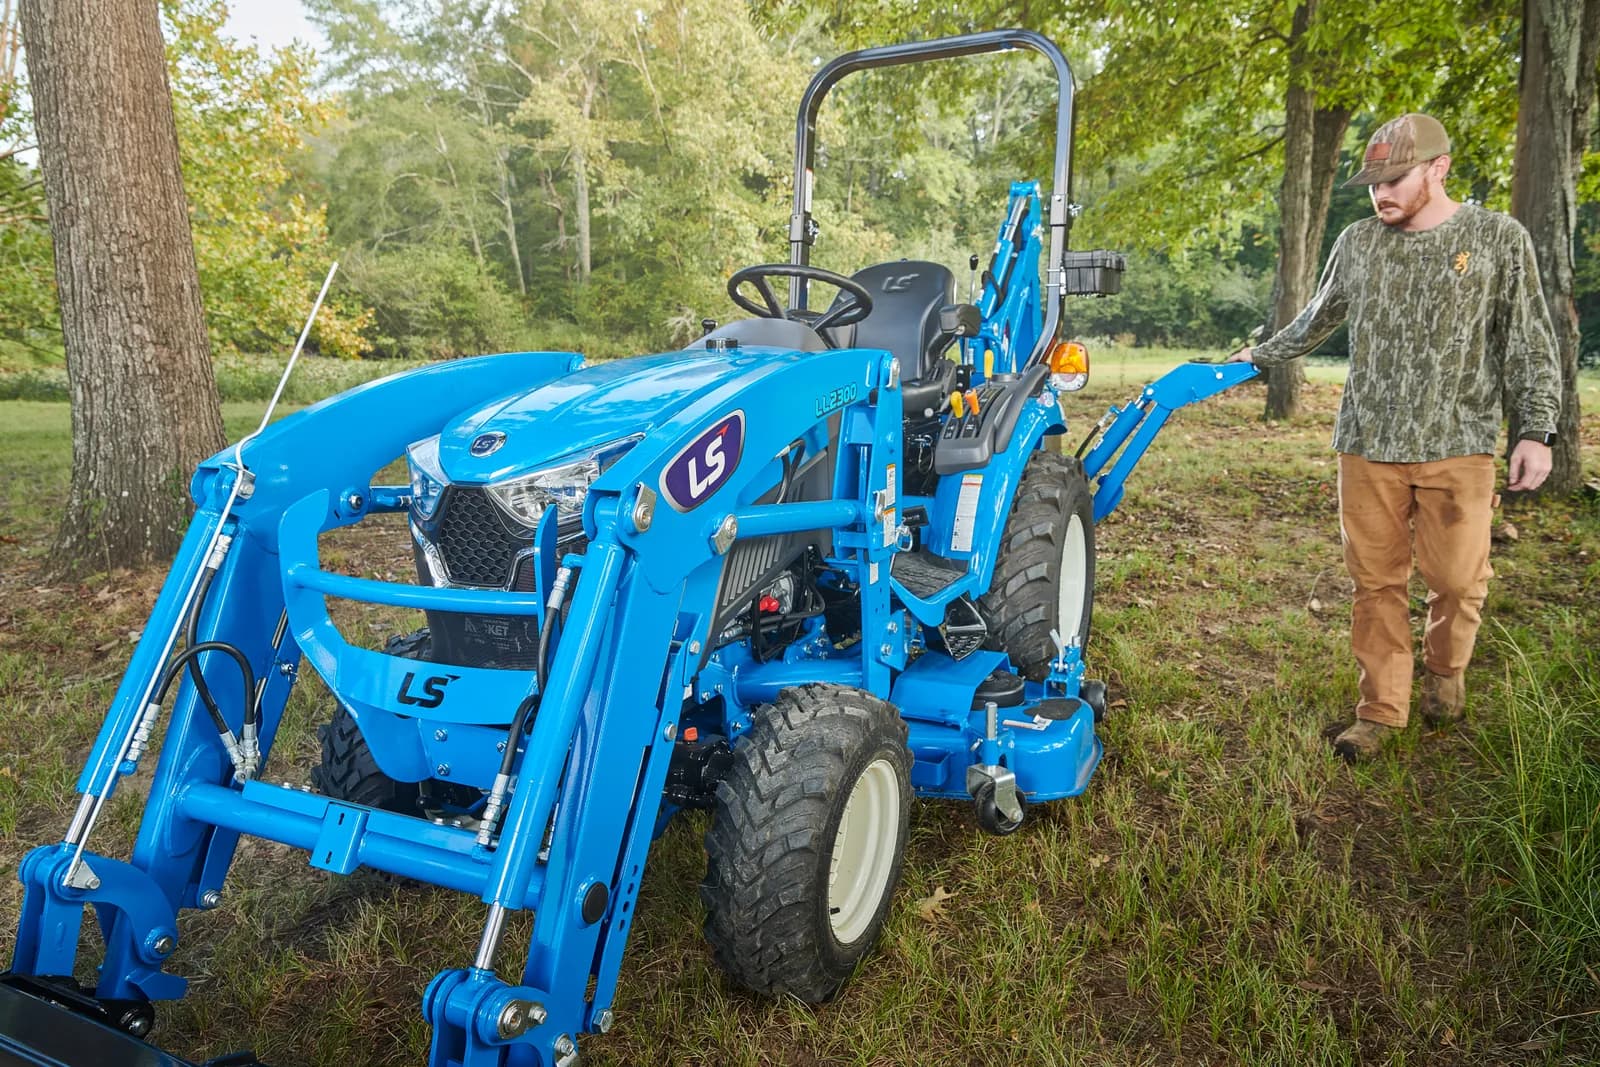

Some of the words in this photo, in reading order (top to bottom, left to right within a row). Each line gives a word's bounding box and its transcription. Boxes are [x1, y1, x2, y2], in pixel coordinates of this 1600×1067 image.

[815, 382, 857, 418] LL2300
[473, 438, 493, 449] LS
[688, 433, 726, 499] LS
[397, 672, 451, 708] LS
